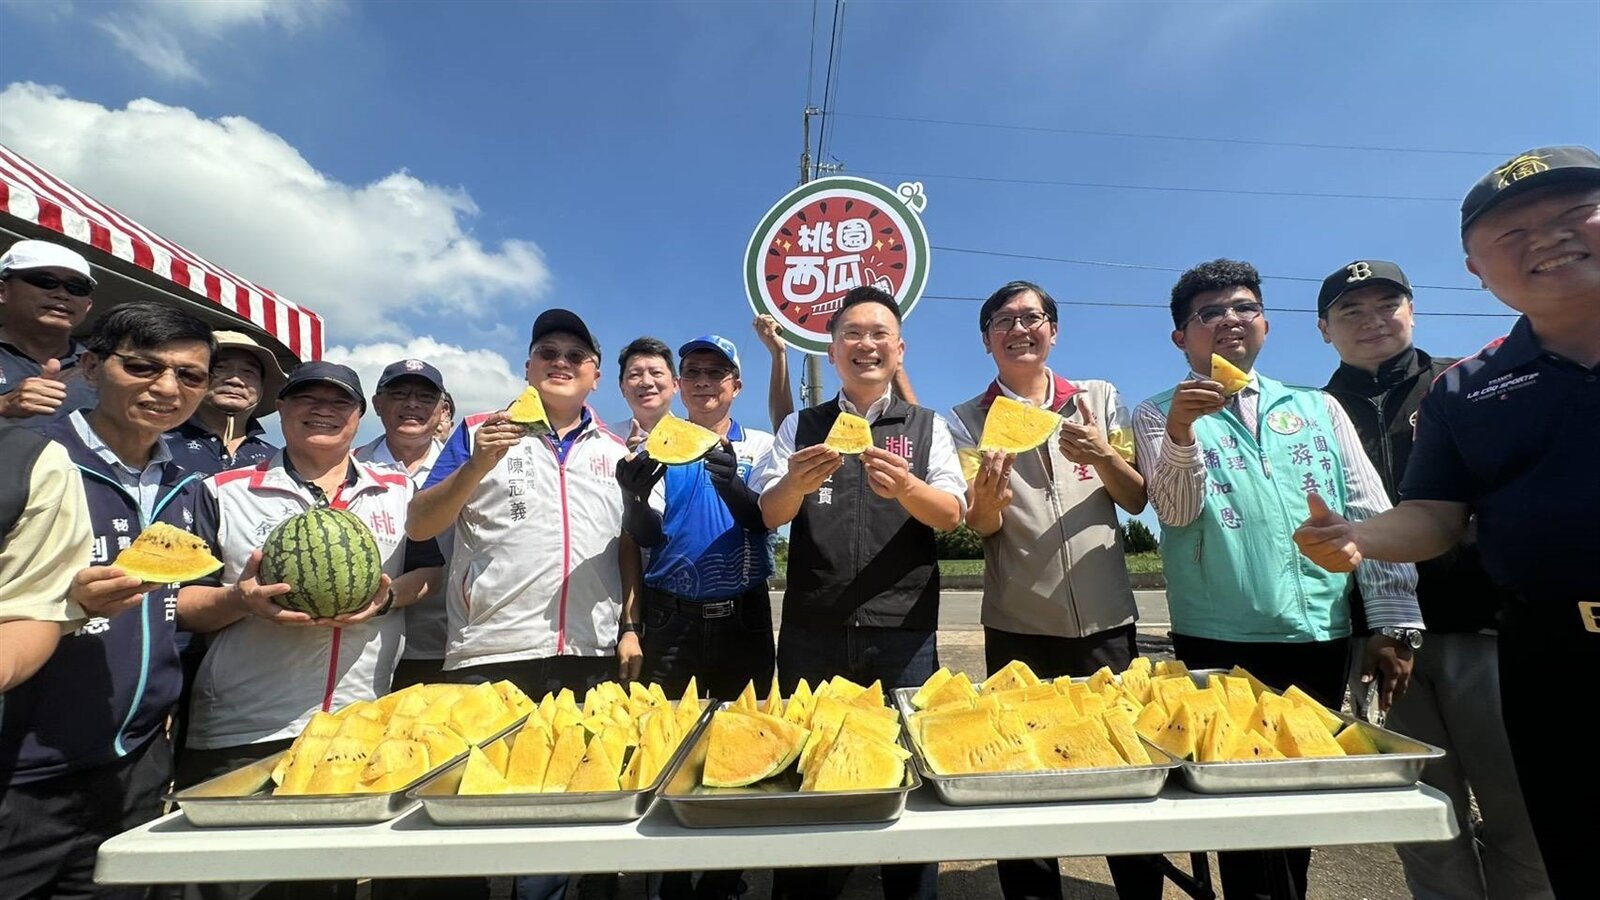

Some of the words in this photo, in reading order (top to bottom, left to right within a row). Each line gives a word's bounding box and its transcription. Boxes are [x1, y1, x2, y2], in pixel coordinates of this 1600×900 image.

[798, 218, 873, 253] 桃園
[781, 254, 863, 303] 西瓜
[1346, 261, 1373, 283] B
[1220, 435, 1247, 470] 助理
[507, 456, 527, 521] 陳冠義
